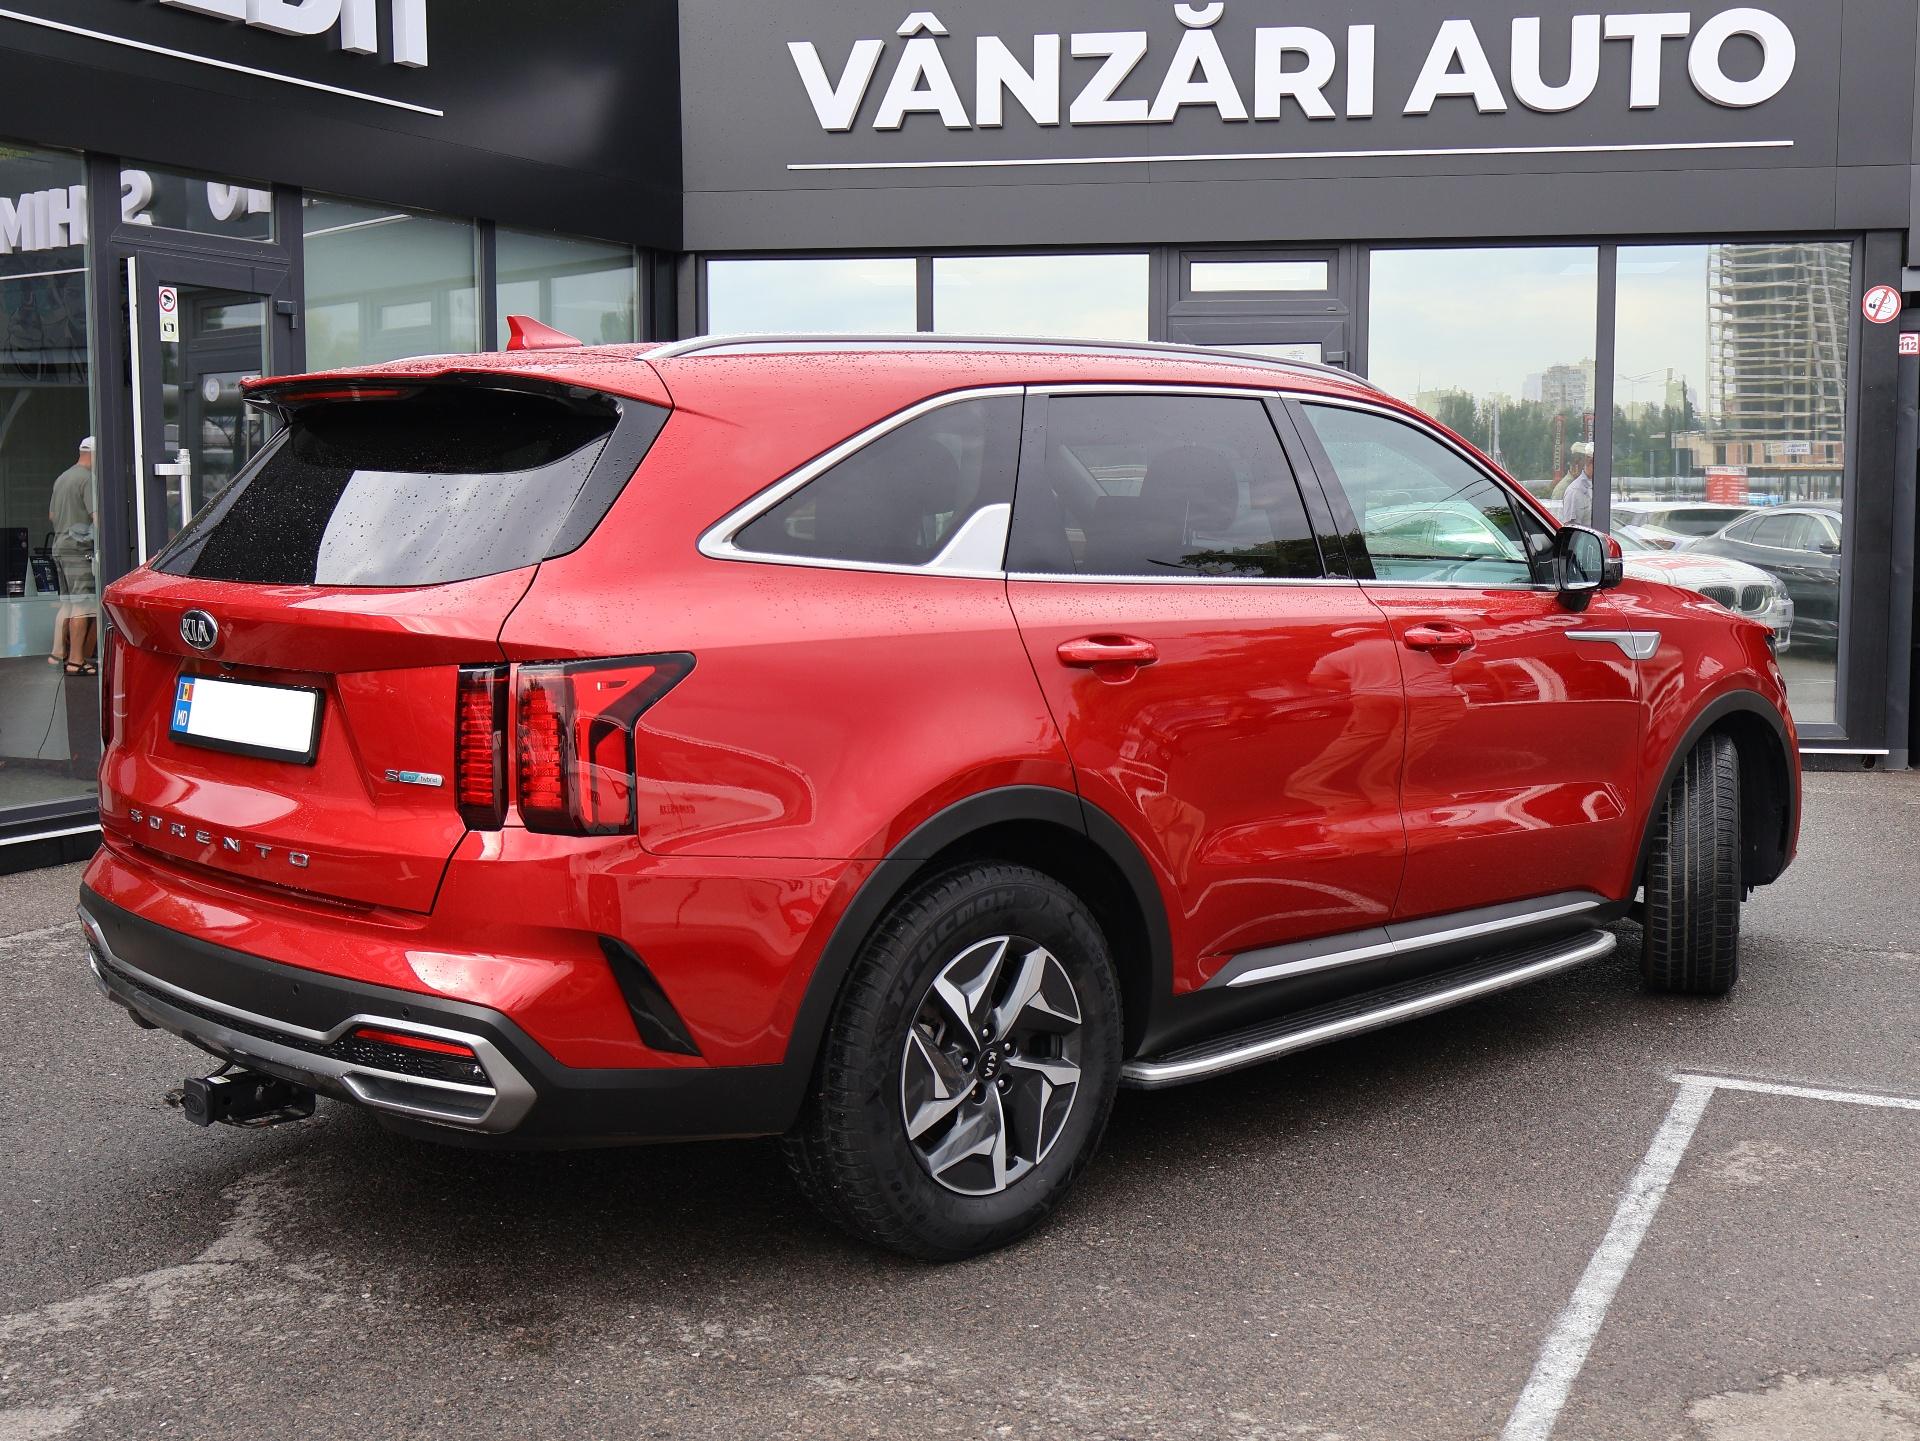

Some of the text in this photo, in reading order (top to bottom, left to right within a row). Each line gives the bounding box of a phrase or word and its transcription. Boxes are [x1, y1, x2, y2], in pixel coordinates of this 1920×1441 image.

[788, 0, 1797, 132] VÂNZĂRI AUTO
[1900, 341, 1917, 350] 112
[183, 618, 211, 643] KIA
[175, 709, 189, 728] MD
[129, 808, 310, 867] SORENTO
[984, 1051, 998, 1077] KIA
